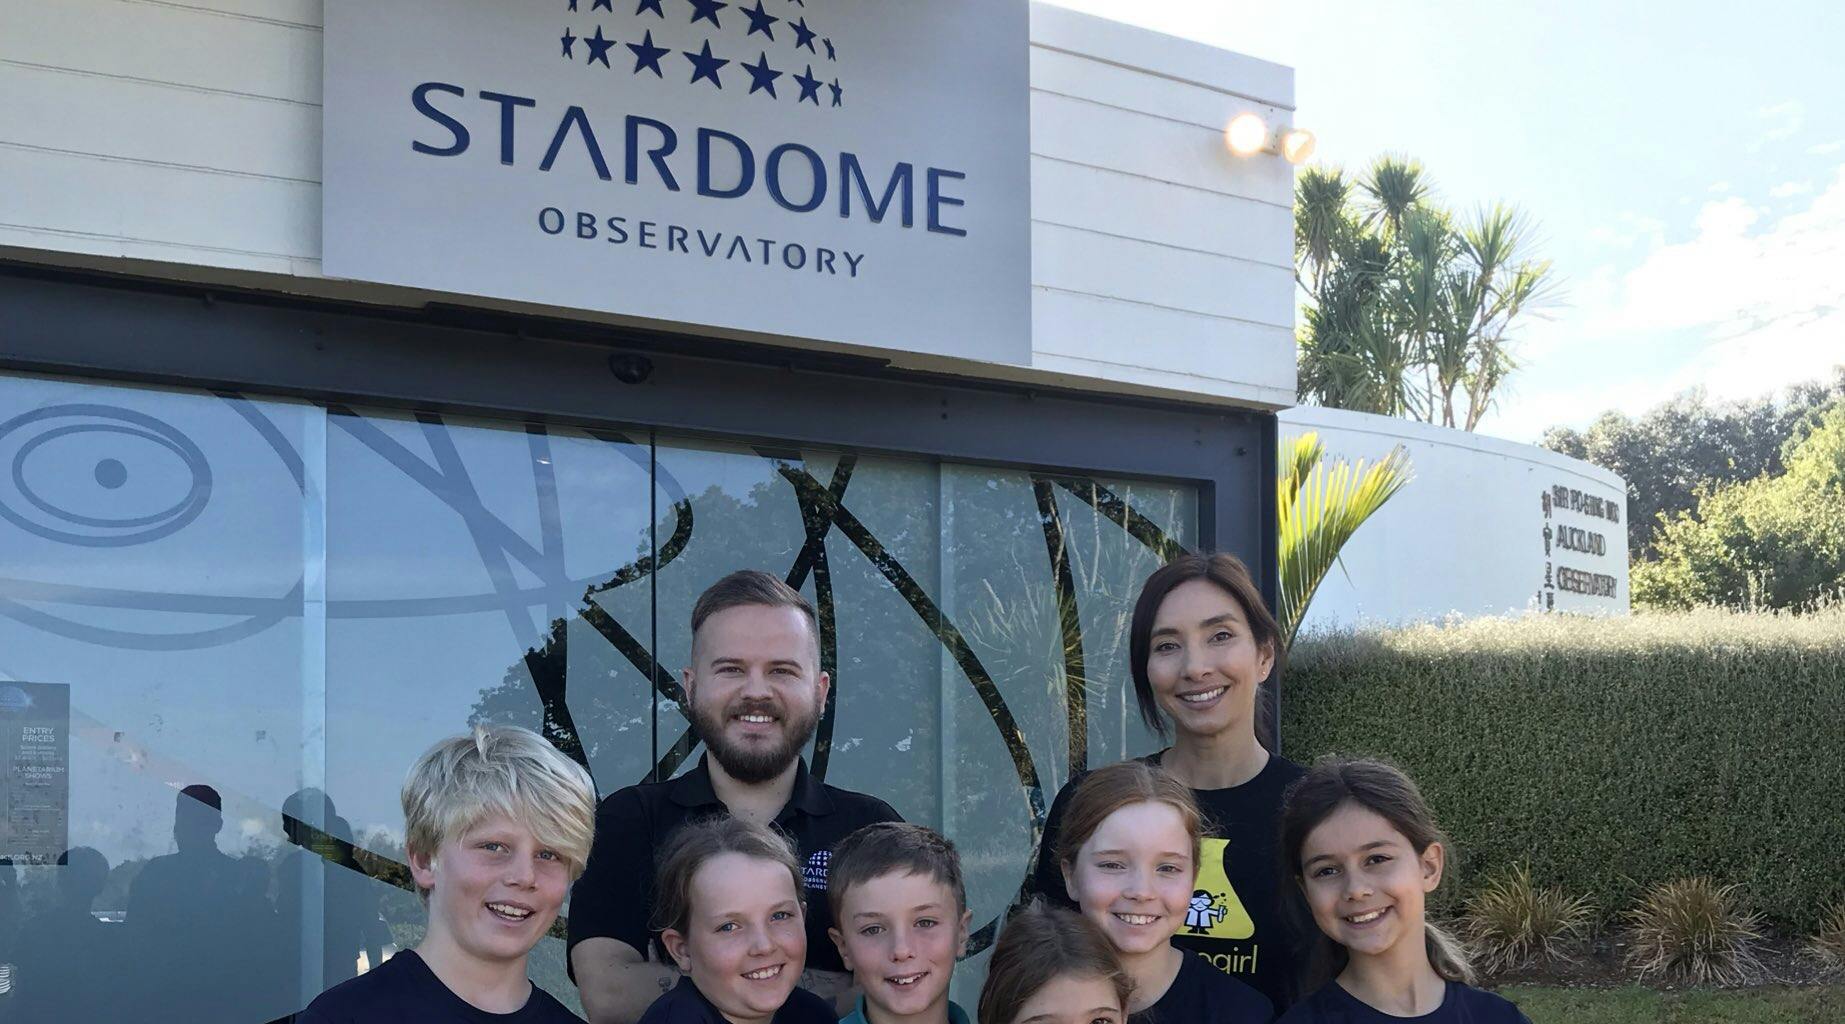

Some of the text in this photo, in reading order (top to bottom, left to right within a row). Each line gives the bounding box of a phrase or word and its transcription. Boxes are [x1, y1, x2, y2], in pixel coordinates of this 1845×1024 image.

[411, 82, 967, 237] STARDOME
[538, 206, 865, 278] OBSERVATORY
[1555, 524, 1607, 557] AUCKLAND
[22, 734, 55, 742] PRICES
